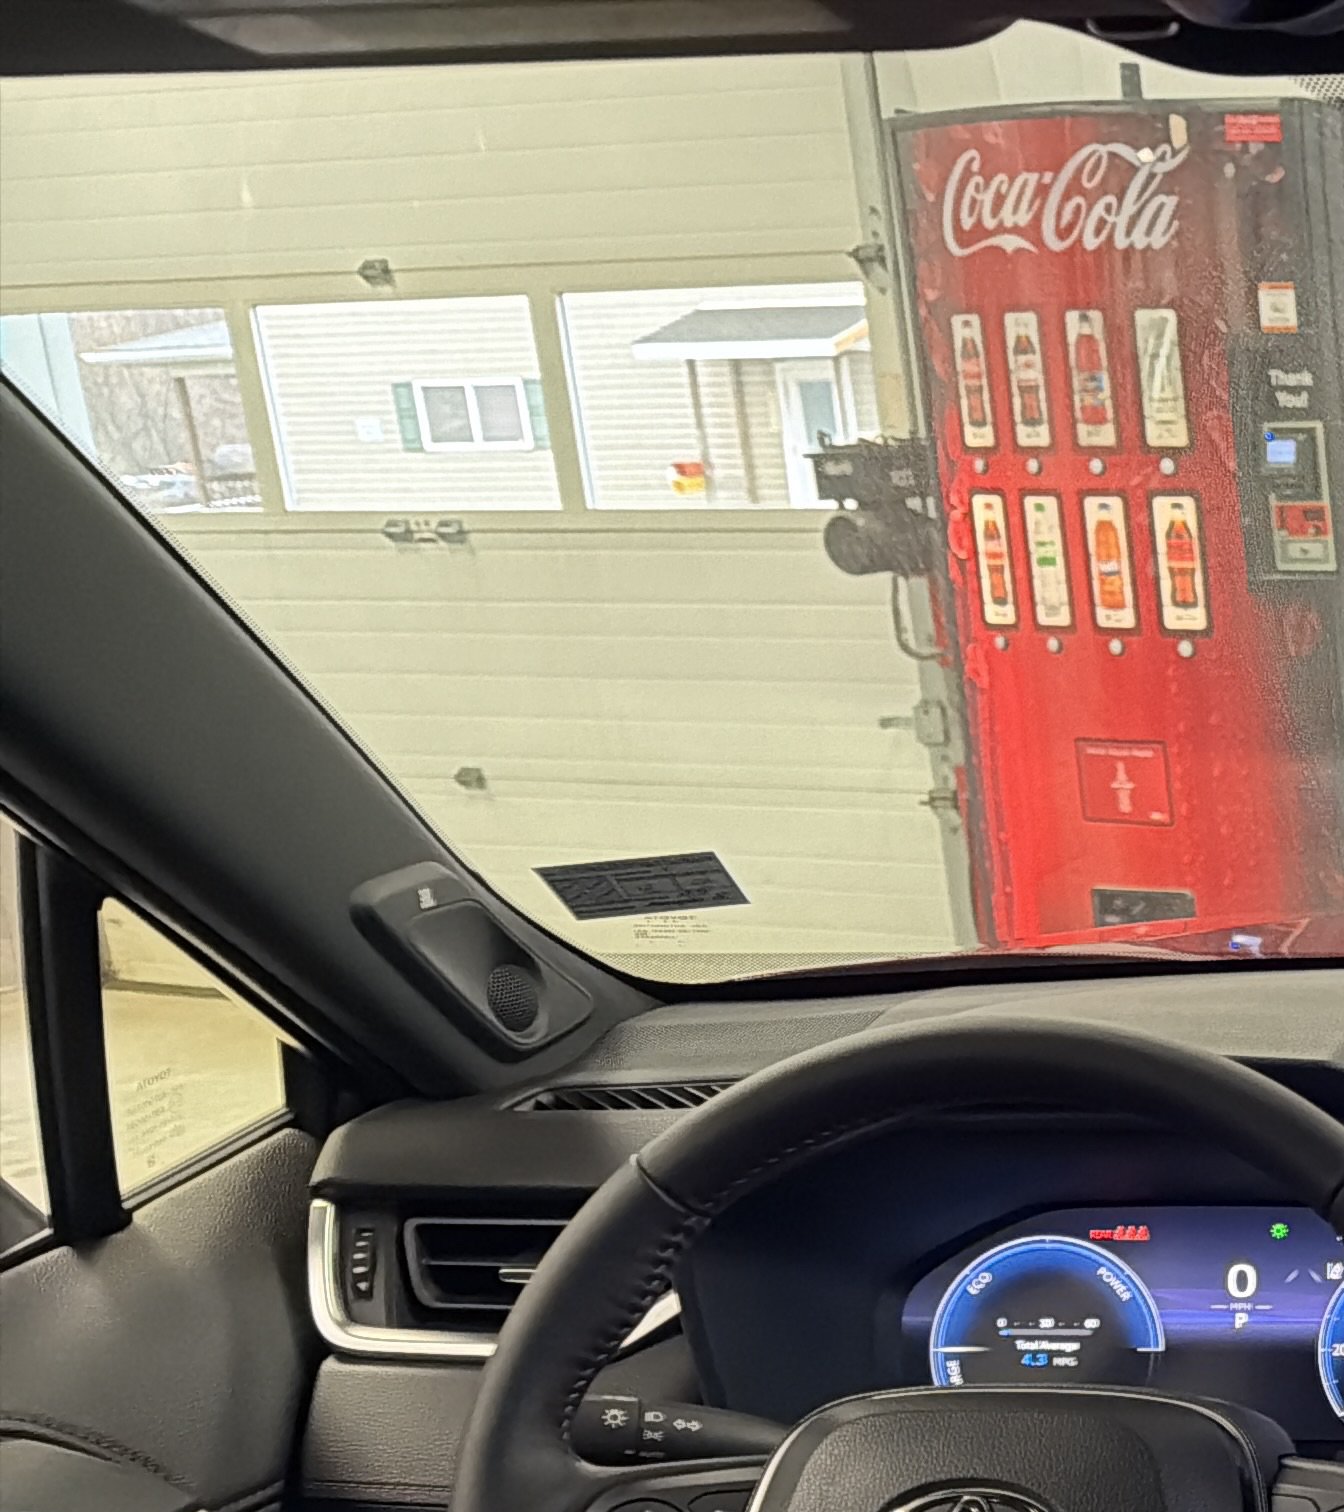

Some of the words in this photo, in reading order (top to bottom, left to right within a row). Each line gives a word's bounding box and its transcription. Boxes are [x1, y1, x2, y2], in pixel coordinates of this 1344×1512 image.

[942, 142, 1189, 257] Coca-Cola
[965, 1271, 993, 1296] ECO
[1096, 1266, 1133, 1302] POWER
[1227, 1263, 1257, 1298] 0
[1234, 1312, 1249, 1329] P
